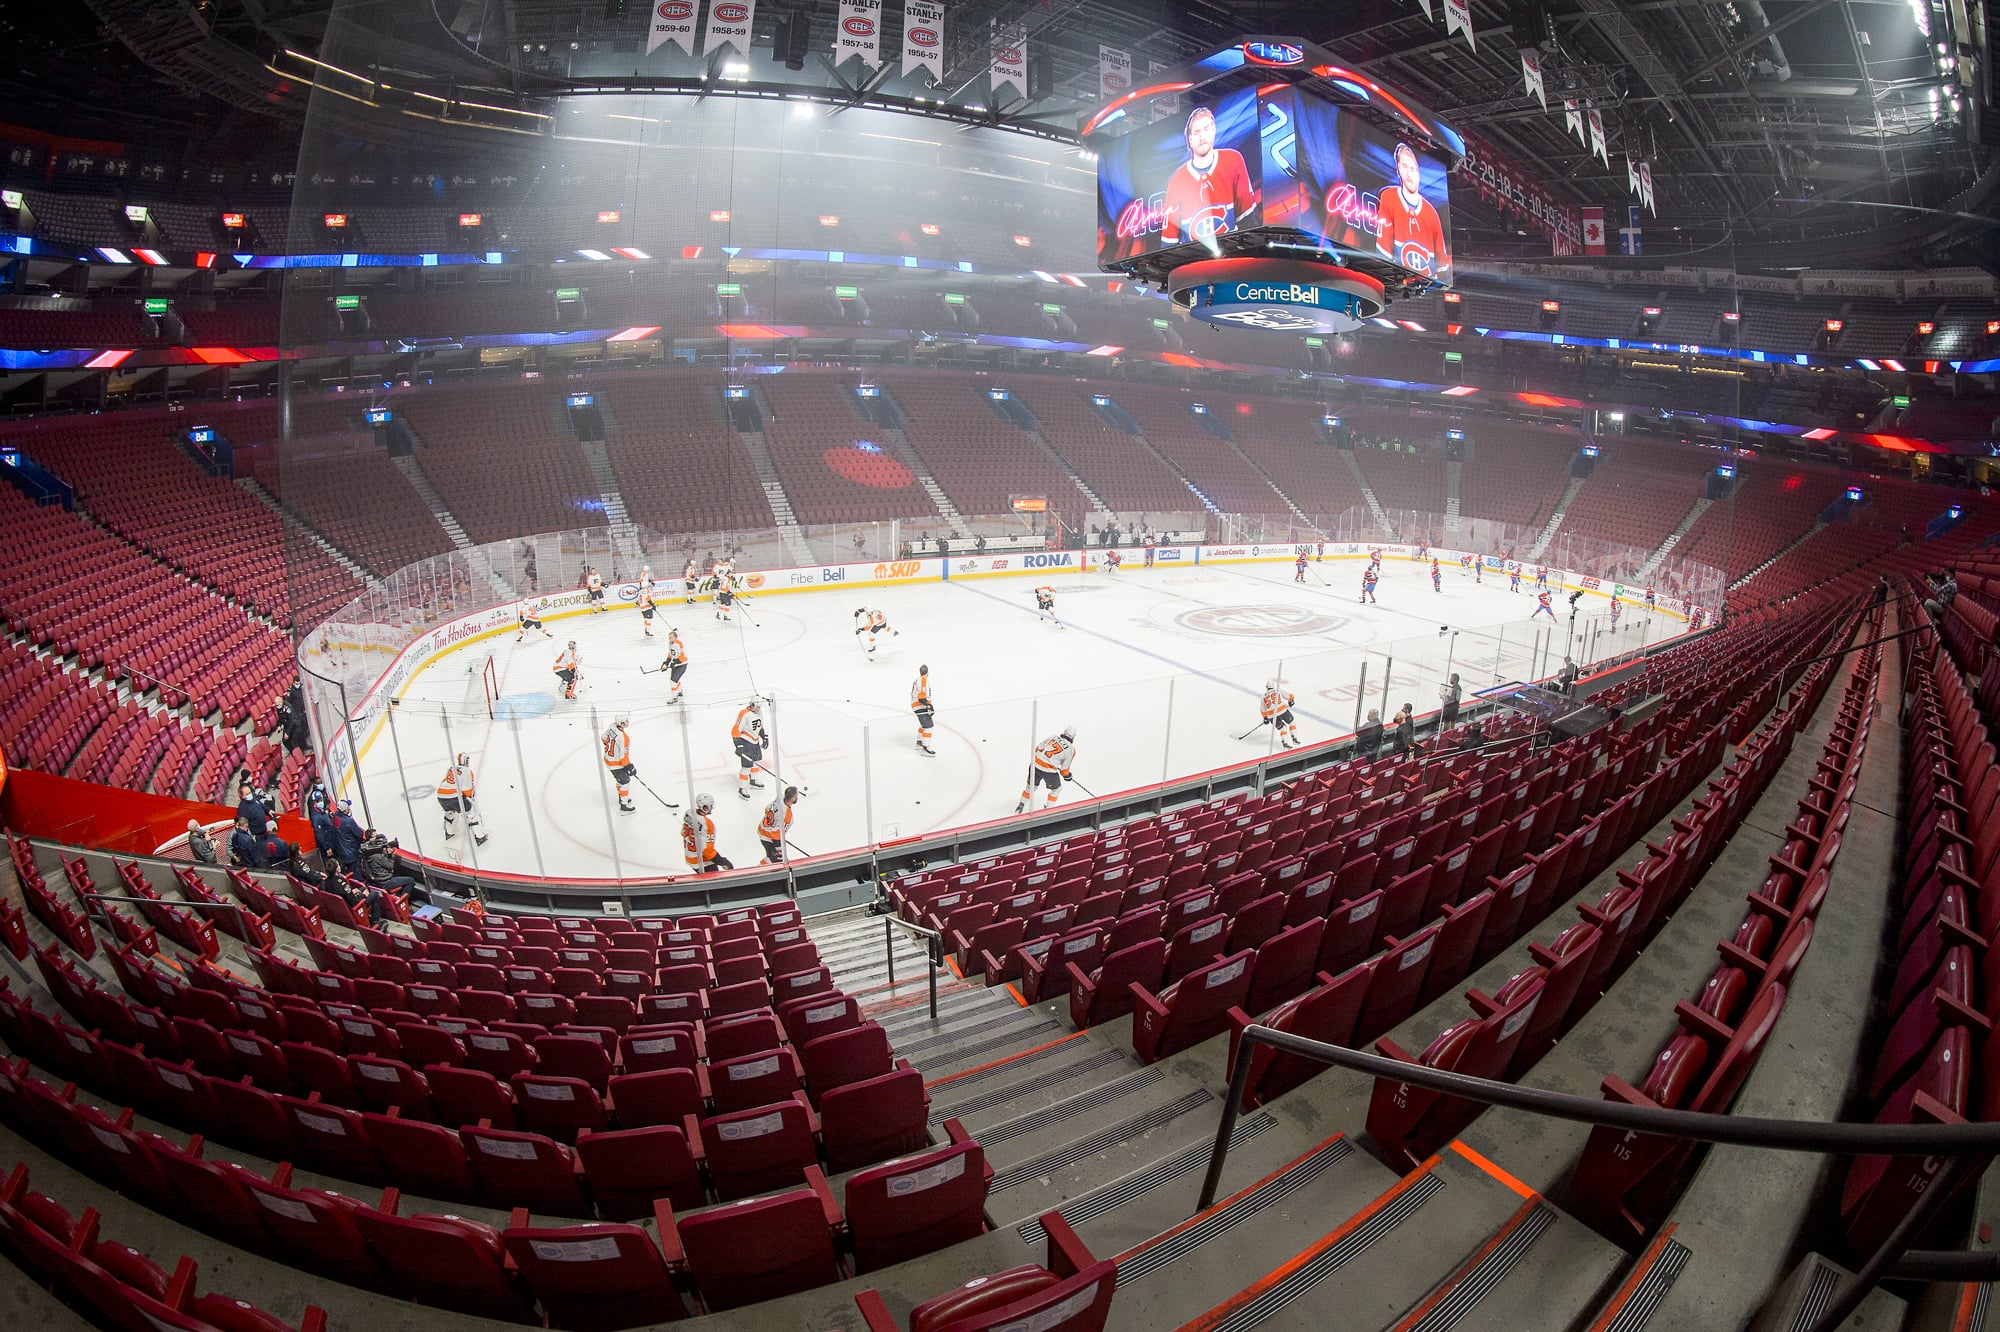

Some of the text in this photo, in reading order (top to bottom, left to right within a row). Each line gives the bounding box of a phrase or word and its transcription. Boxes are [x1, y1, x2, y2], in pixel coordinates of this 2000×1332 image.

[841, 0, 881, 10] STANLEY
[914, 2, 936, 11] COUPE
[906, 6, 943, 21] STANLEY
[655, 24, 691, 33] 1959-60
[711, 26, 747, 36] 1958-59
[841, 38, 875, 50] 1957-58
[907, 48, 939, 60] 1956-57
[1101, 53, 1130, 68] STANLEY
[993, 65, 1023, 78] 1955-56
[1480, 161, 1496, 189] 29
[992, 560, 1009, 569] IGA
[1023, 553, 1072, 568] RONA
[790, 568, 845, 584] Fibe Bell
[888, 561, 921, 578] SKIP
[1580, 576, 1601, 590] IGA
[651, 589, 677, 598] uprême
[553, 594, 588, 608] EXPORT
[432, 622, 482, 651] Tim Hortons
[332, 738, 349, 774] Bell
[705, 834, 717, 842] 25
[1145, 1010, 1153, 1022] C
[1398, 1082, 1409, 1097] E
[1392, 1093, 1407, 1109] 115
[1623, 1129, 1637, 1143] F
[1612, 1143, 1632, 1161] 115
[1906, 1173, 1929, 1193] 115
